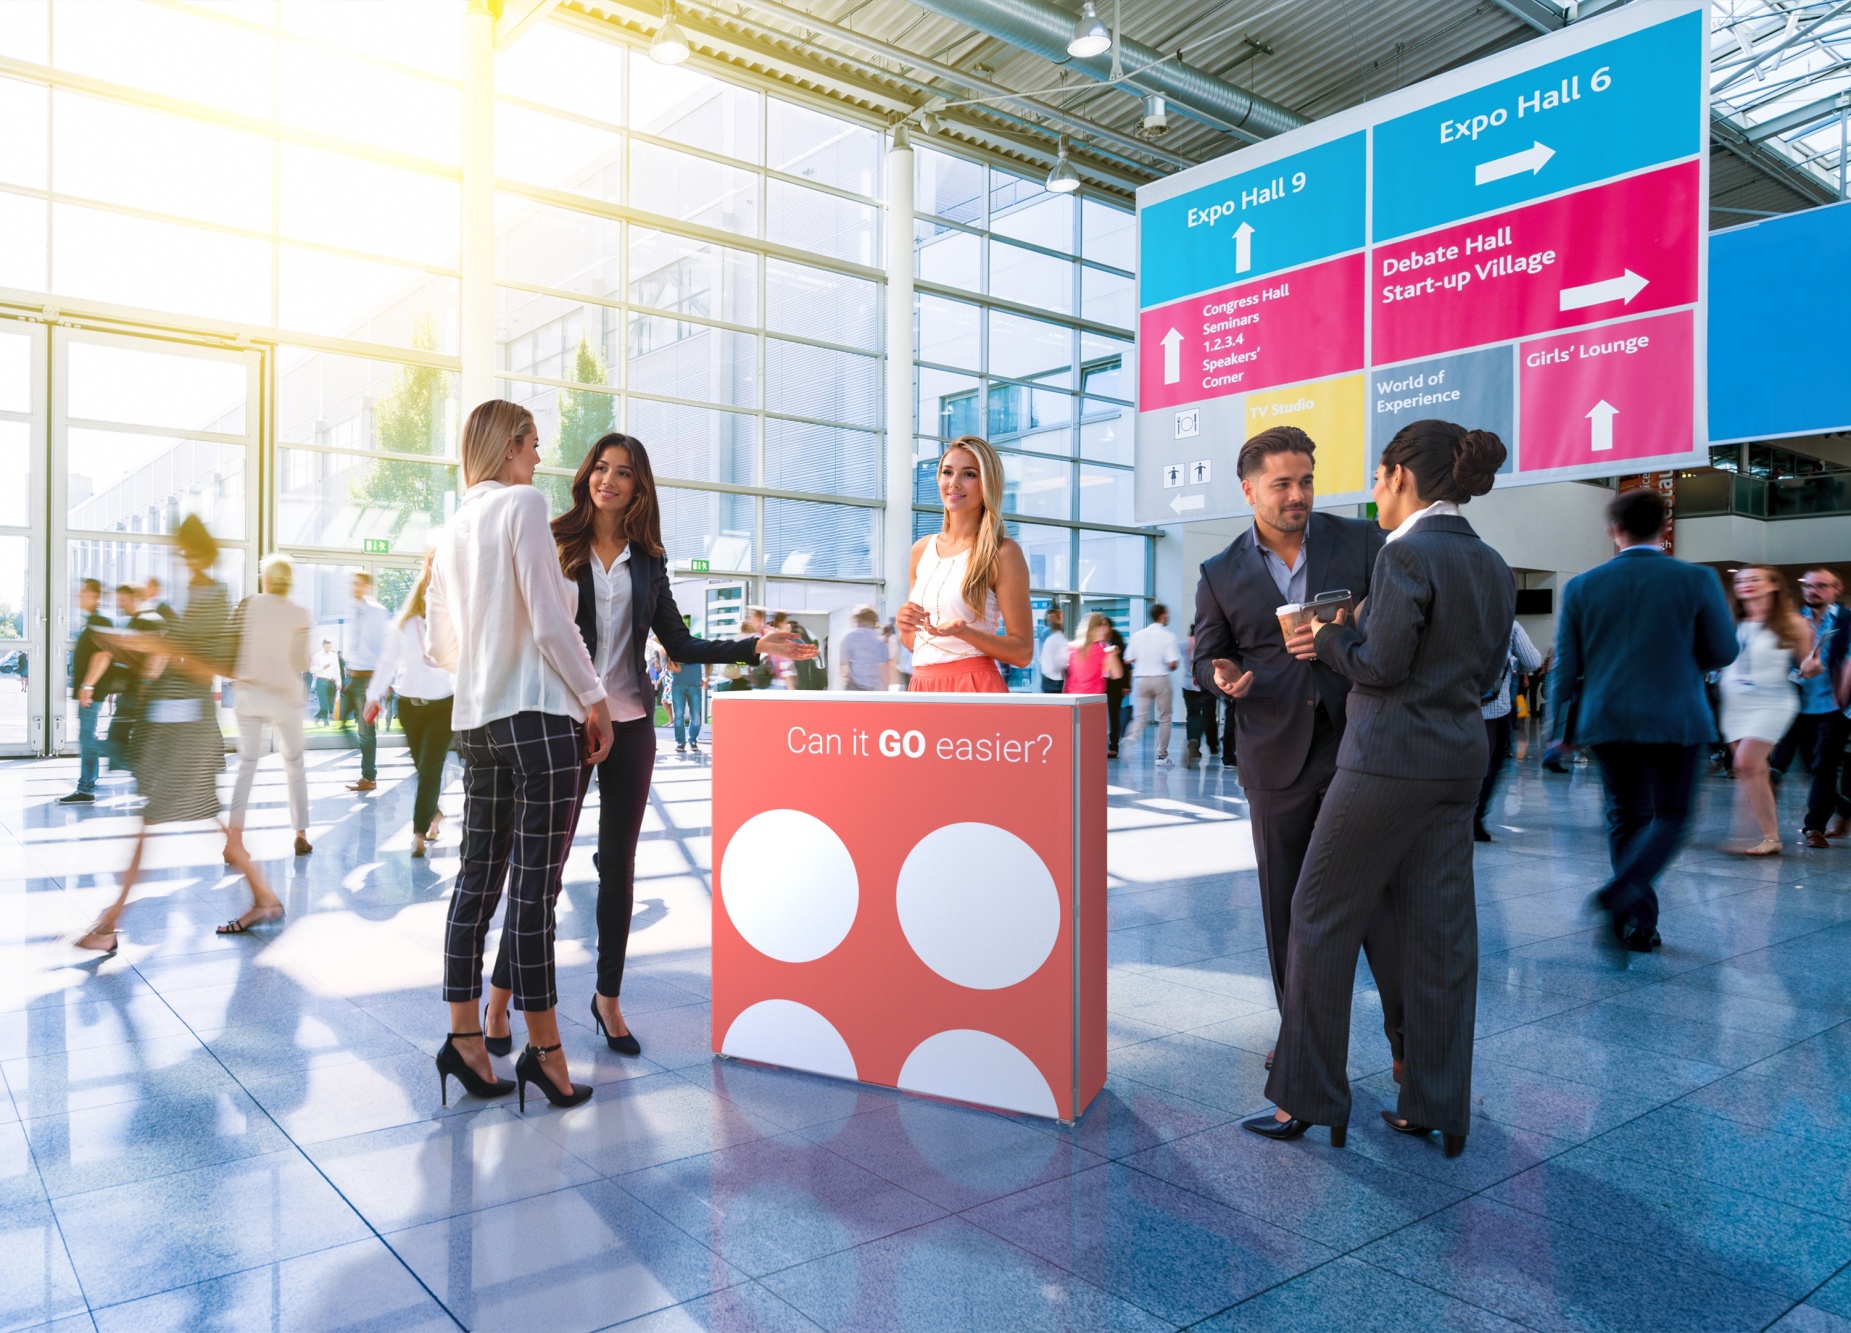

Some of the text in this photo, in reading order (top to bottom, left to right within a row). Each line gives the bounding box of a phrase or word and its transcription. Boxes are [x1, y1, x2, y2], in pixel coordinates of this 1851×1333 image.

[1440, 66, 1612, 144] Expo Hall 6
[1188, 171, 1306, 228] Expo Hall 9
[1383, 226, 1512, 277] Debate Hall
[1382, 249, 1556, 304] Start-up Village
[1203, 283, 1289, 317] Congress Hall
[1203, 313, 1259, 335] Seminars
[1203, 332, 1244, 353] 1.2.3.4
[1526, 335, 1649, 368] Girls’ Lounge
[1202, 346, 1260, 373] Speakers’
[1202, 372, 1244, 389] Corner
[1376, 370, 1445, 395] World of
[1250, 398, 1315, 419] TV Studio
[1377, 389, 1460, 414] Experience
[787, 726, 1053, 764] Can it GO easier?
